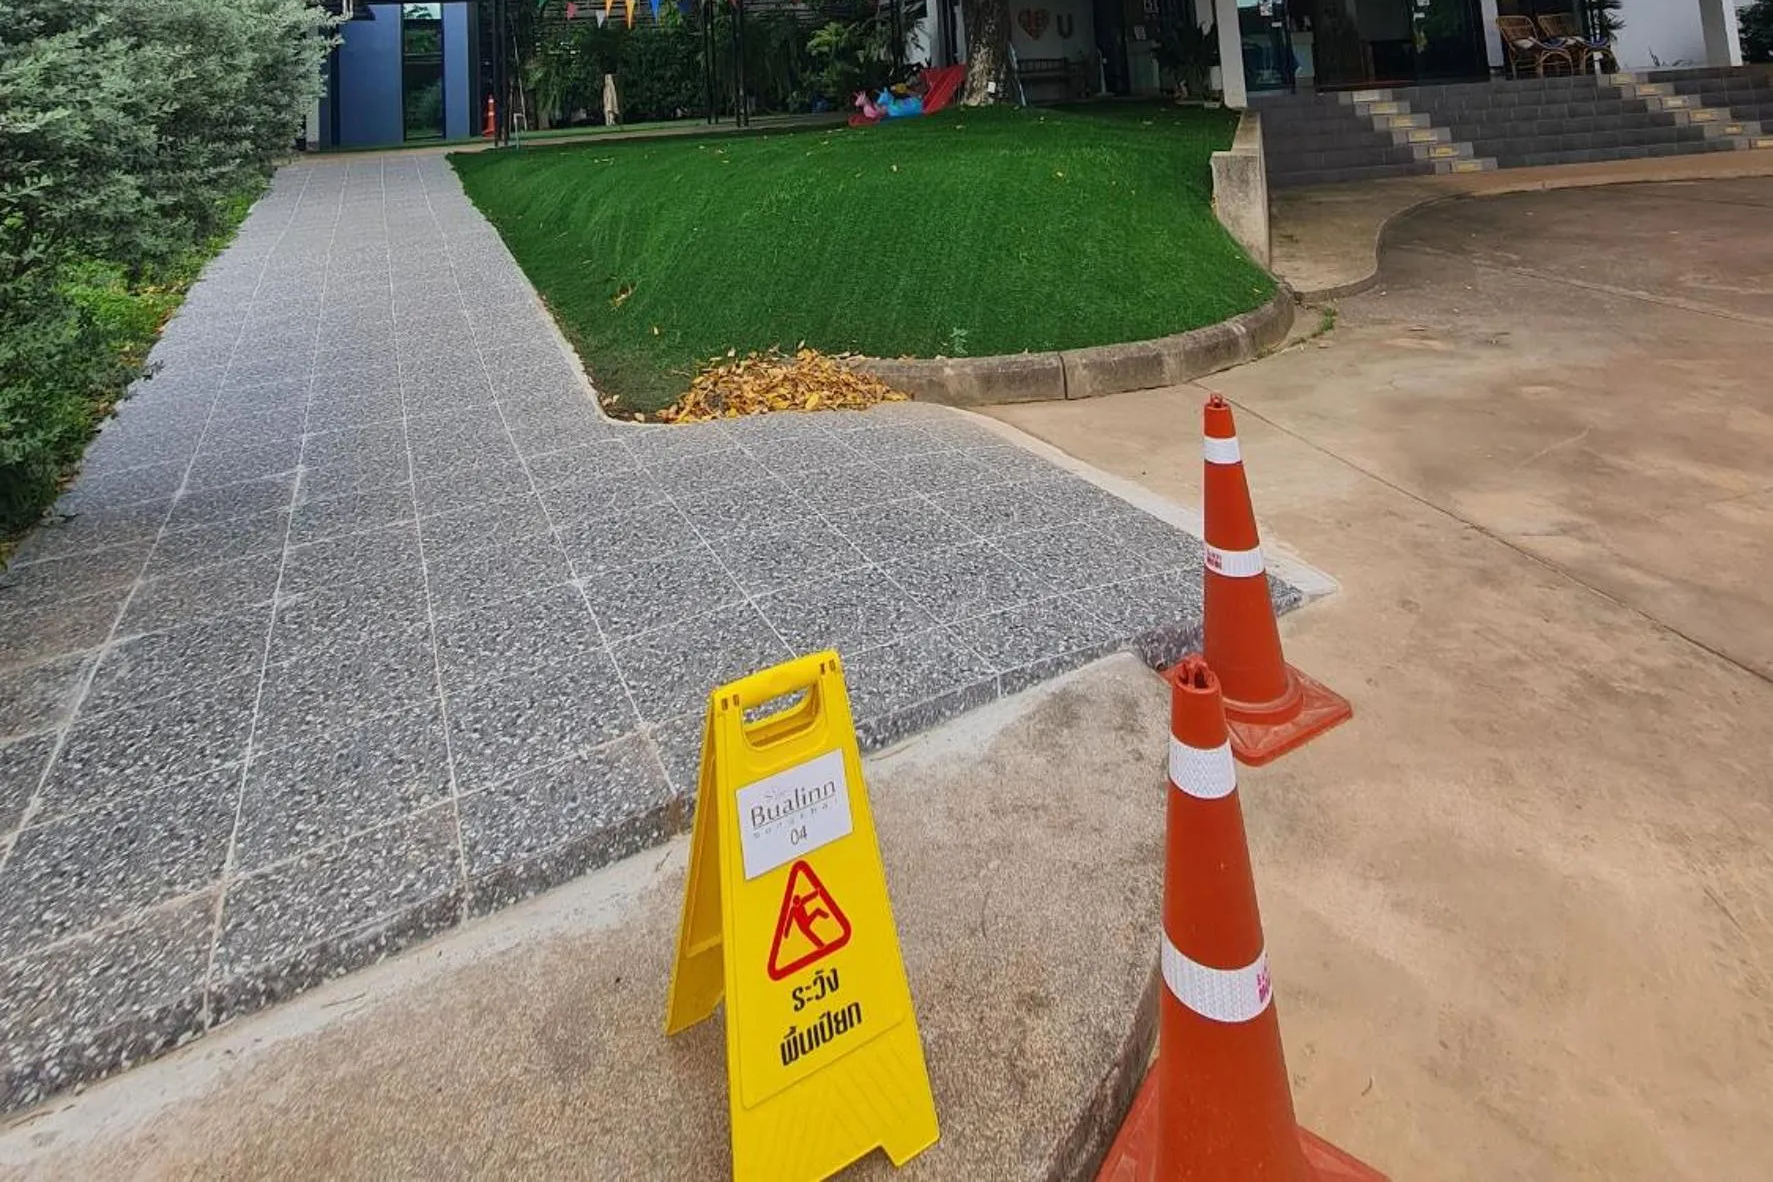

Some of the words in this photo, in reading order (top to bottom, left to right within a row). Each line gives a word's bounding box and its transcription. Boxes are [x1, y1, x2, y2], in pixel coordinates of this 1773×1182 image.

[1056, 13, 1074, 40] U
[750, 780, 836, 828] Bualinn
[790, 824, 808, 846] 04
[791, 967, 840, 1012] ระวัง
[780, 1001, 863, 1067] พื้นเปียก
